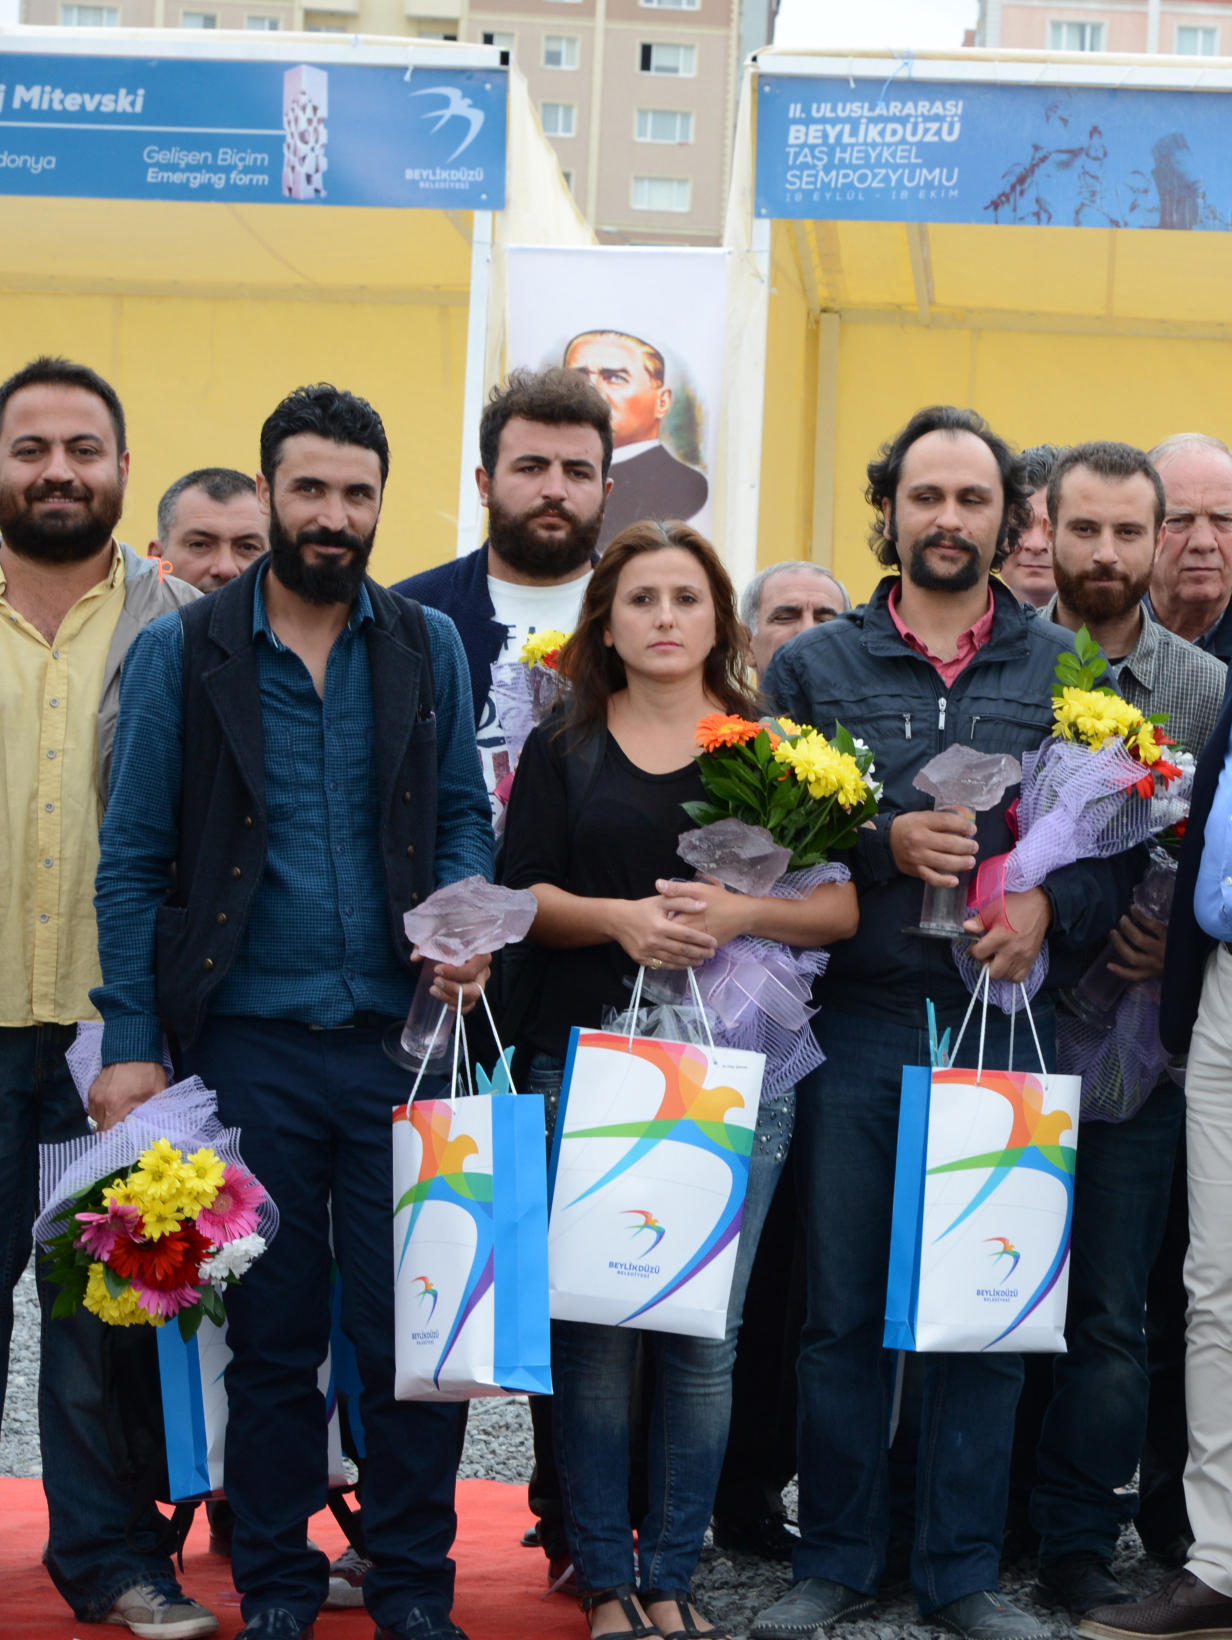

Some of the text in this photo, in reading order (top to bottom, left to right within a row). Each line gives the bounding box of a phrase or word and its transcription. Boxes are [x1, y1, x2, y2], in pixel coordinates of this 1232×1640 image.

[12, 84, 145, 113] Mitevski
[788, 100, 963, 118] II. ULUSLARARASI
[788, 116, 961, 144] BEYLİKDÜZÜ
[143, 146, 268, 170] Gelişen Biçim
[785, 145, 922, 169] TAŞ HEYKEL
[147, 168, 268, 188] Emerging form
[405, 167, 484, 181] BEYLİKDÜZÜ
[785, 167, 958, 189] SEMPOZYUMU
